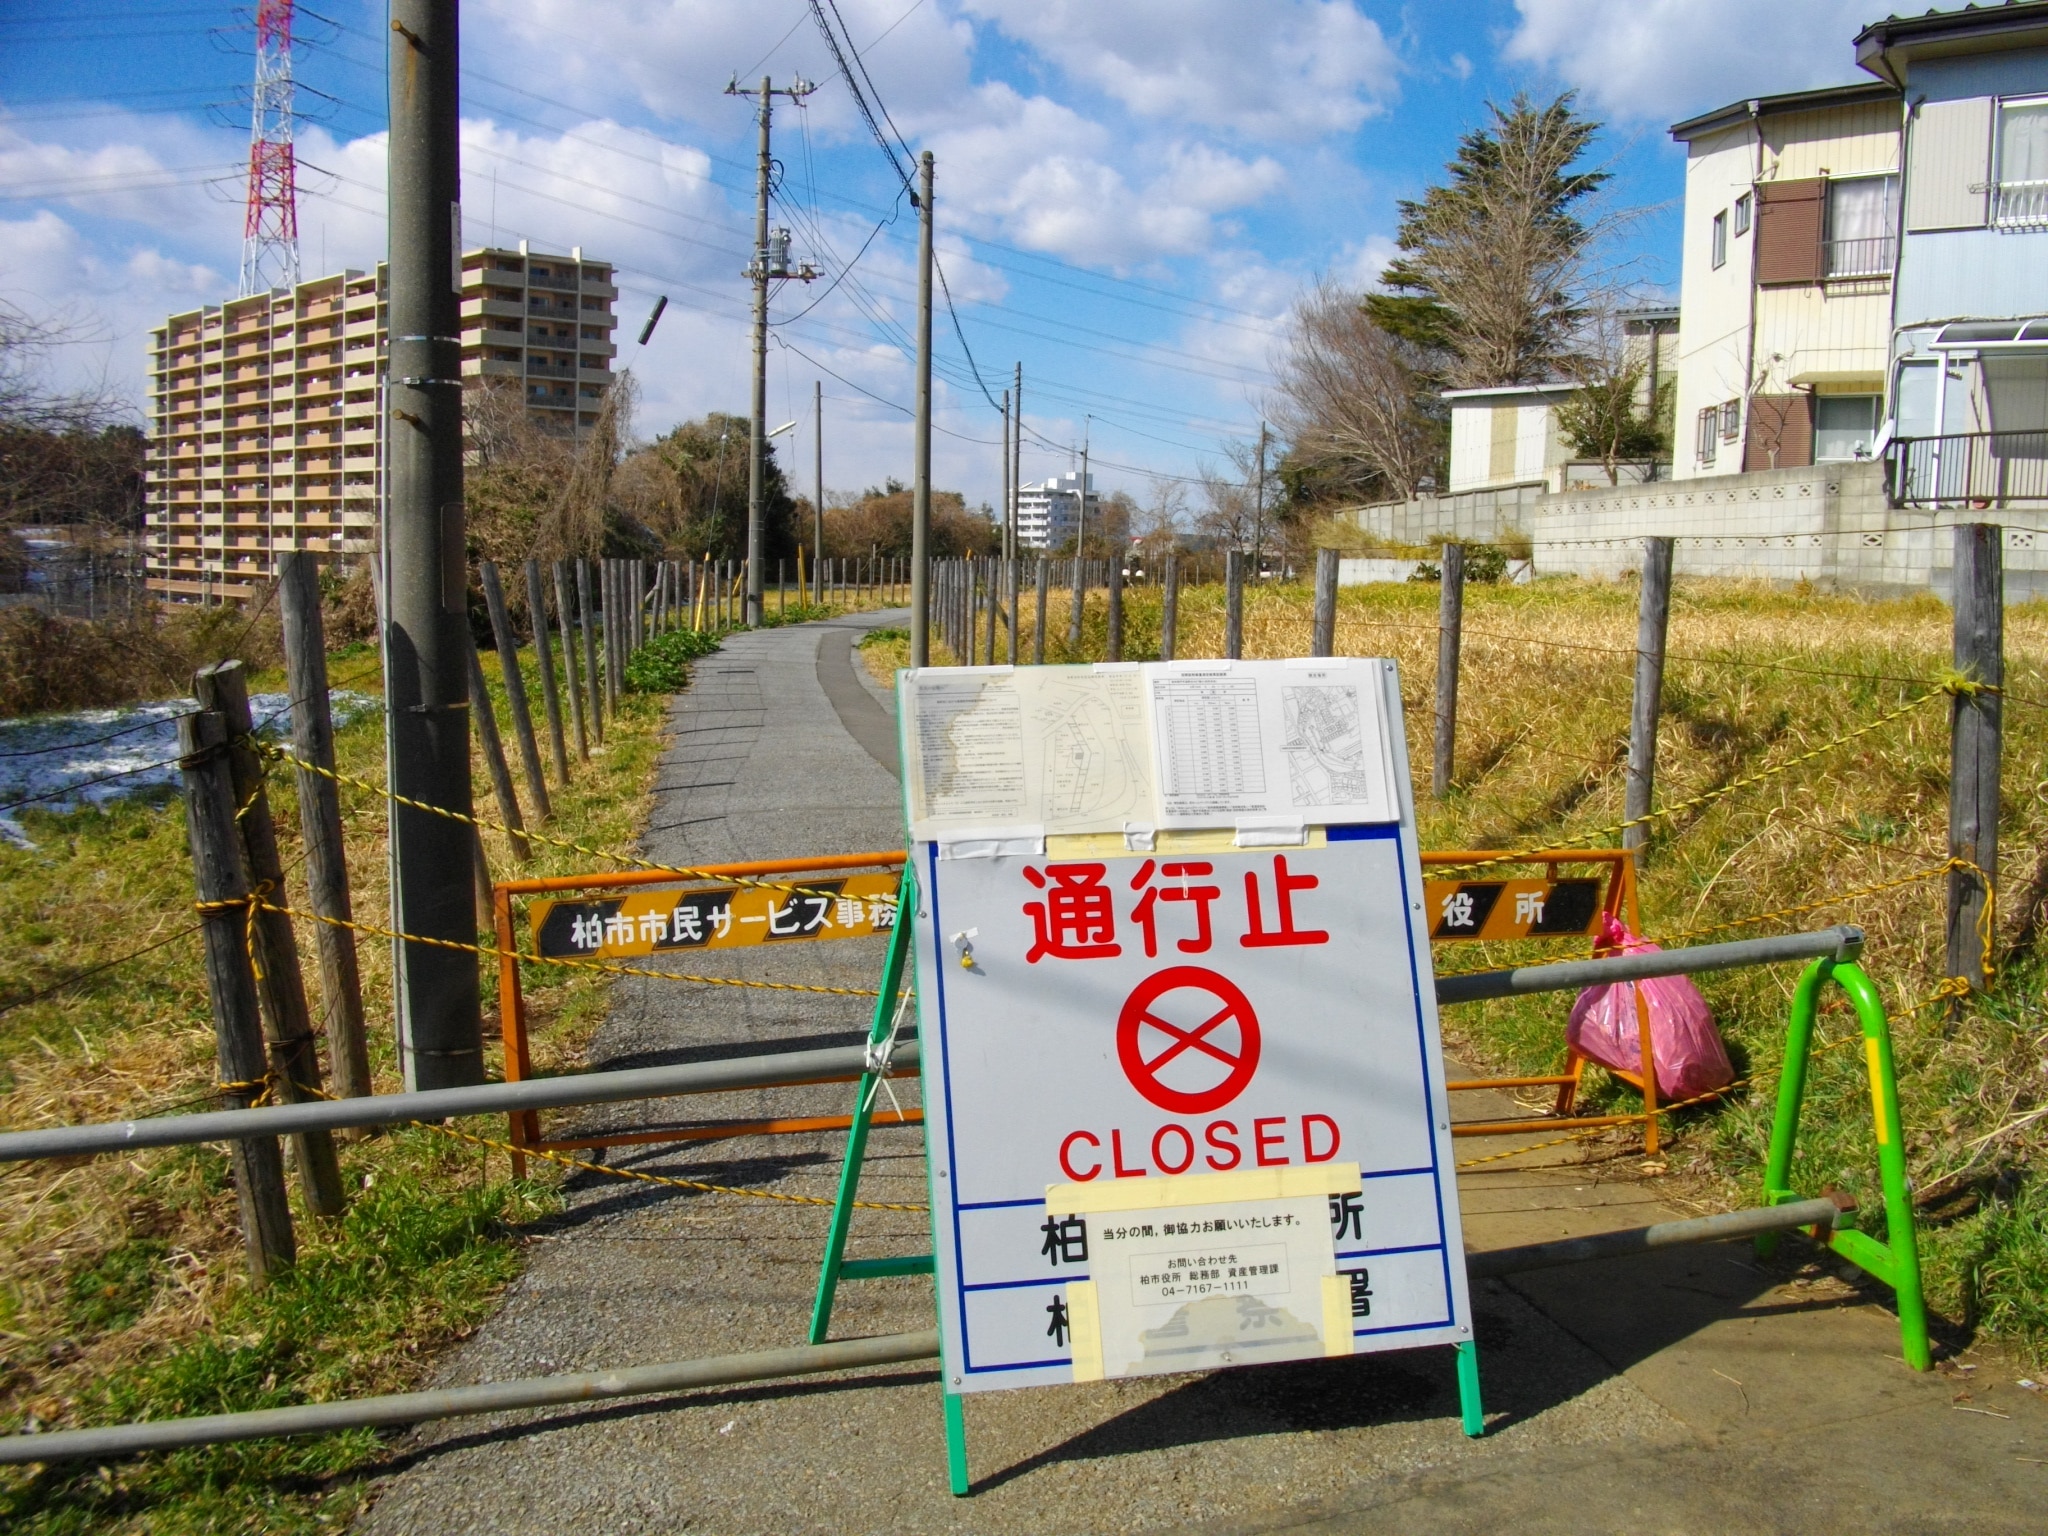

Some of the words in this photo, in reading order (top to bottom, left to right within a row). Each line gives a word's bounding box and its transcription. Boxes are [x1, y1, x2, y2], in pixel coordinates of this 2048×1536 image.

[1022, 854, 1330, 964] 通行止
[1059, 1114, 1341, 1183] CLOSED
[1139, 1272, 1182, 1286] 柏市役所
[1189, 1269, 1220, 1281] 総務部
[1227, 1264, 1280, 1278] 資産管理課
[1167, 1253, 1238, 1269] お問い合わせ先
